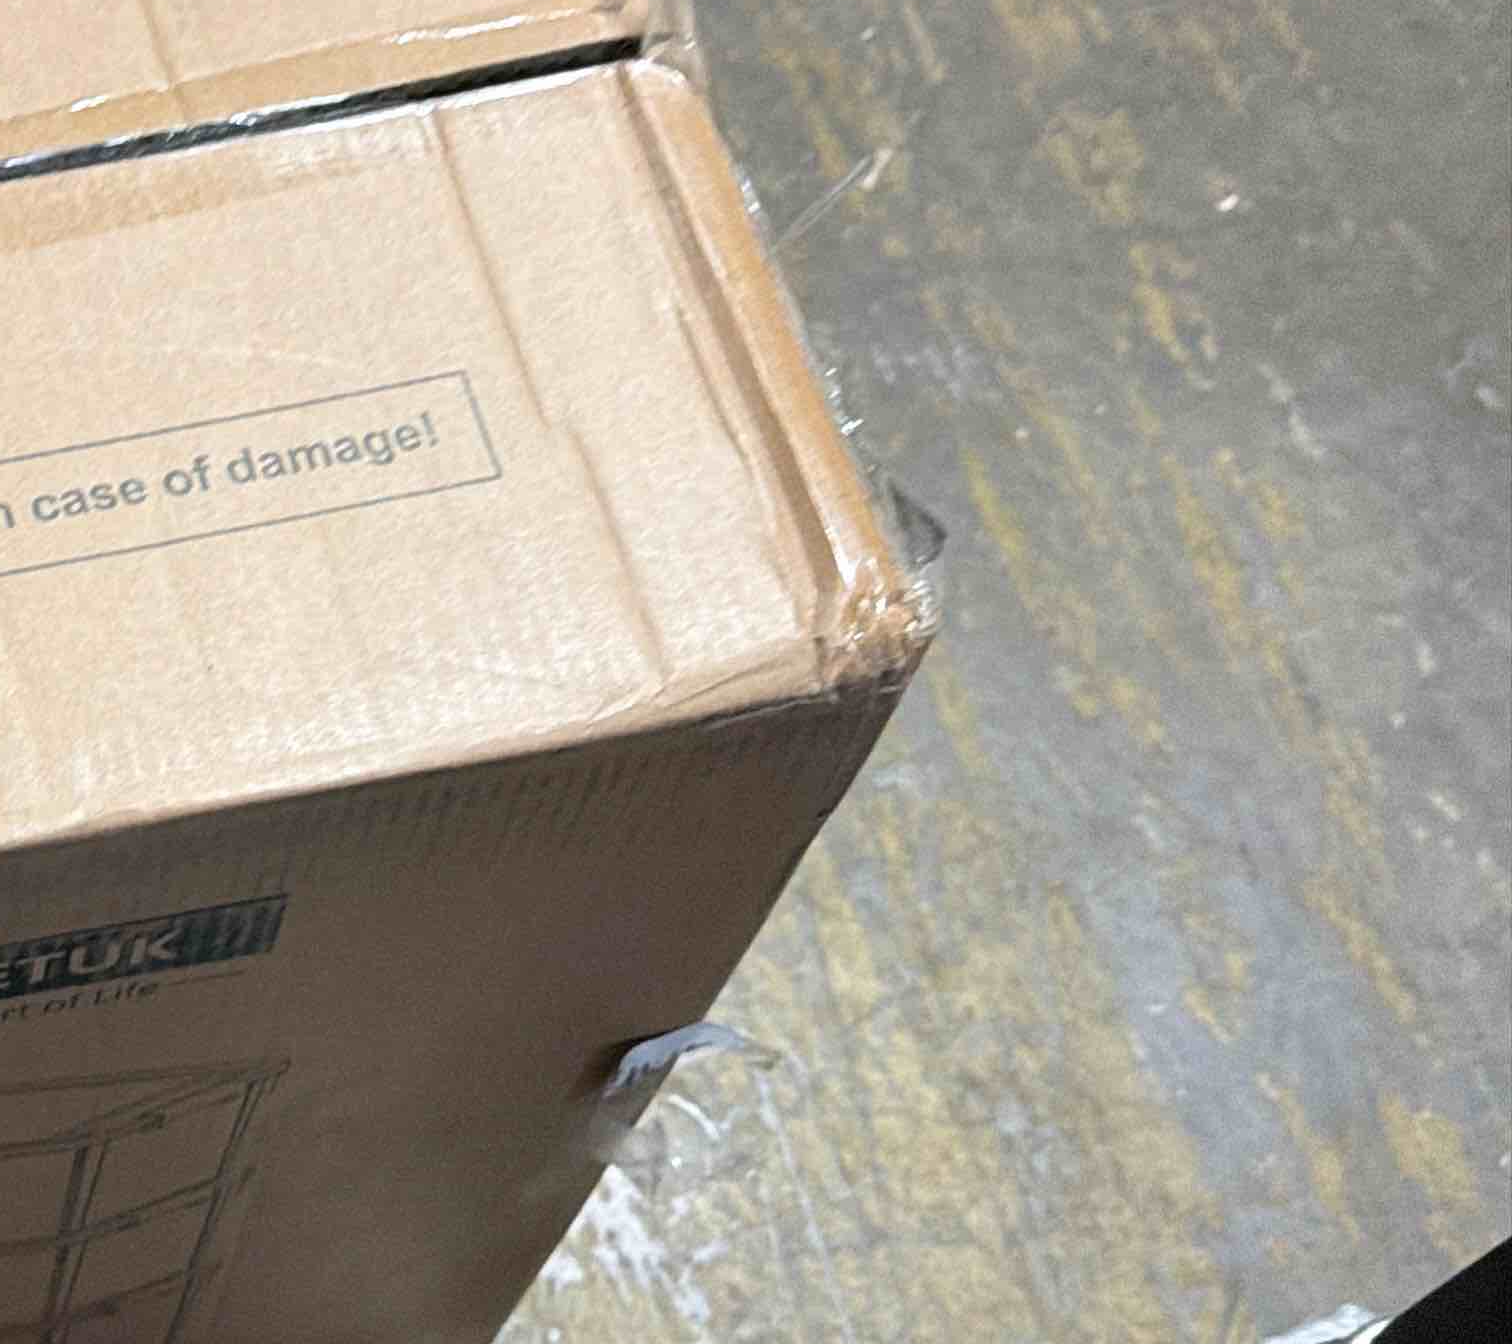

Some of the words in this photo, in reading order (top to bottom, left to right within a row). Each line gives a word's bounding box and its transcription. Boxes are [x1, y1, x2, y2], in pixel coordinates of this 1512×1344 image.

[30, 480, 147, 525] case
[163, 456, 213, 498] of
[227, 412, 440, 485] damage!
[44, 994, 80, 1014] of
[94, 981, 159, 1006] Life
